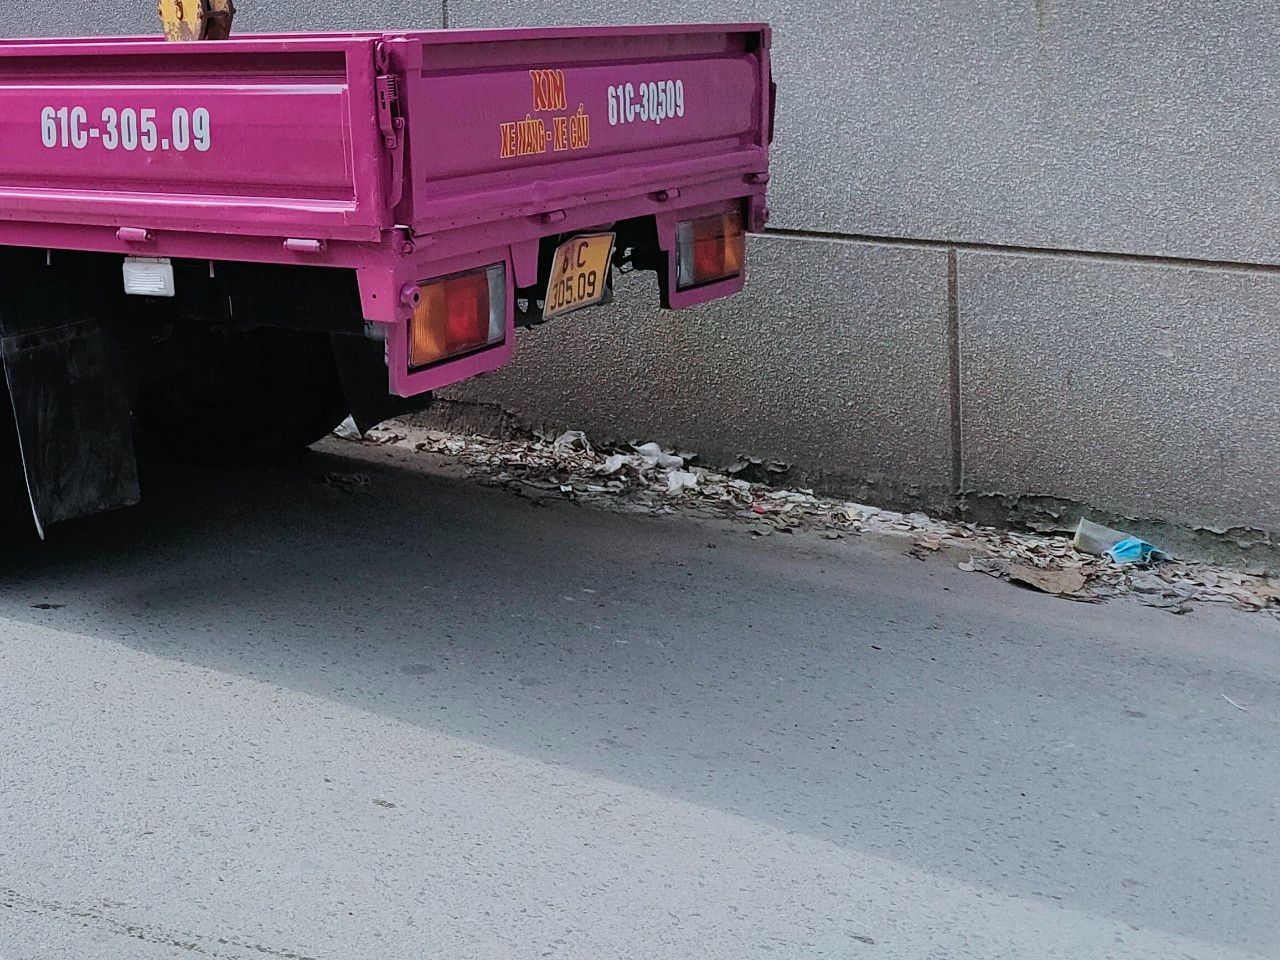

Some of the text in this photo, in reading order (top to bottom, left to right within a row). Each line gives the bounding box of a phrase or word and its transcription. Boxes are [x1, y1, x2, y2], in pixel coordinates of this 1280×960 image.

[529, 69, 567, 112] KIM
[41, 106, 211, 152] 61C-305.09
[500, 122, 516, 158] XE
[517, 114, 546, 155] NÂNG
[553, 117, 567, 151] XE
[550, 241, 597, 311] 61C 305.09
